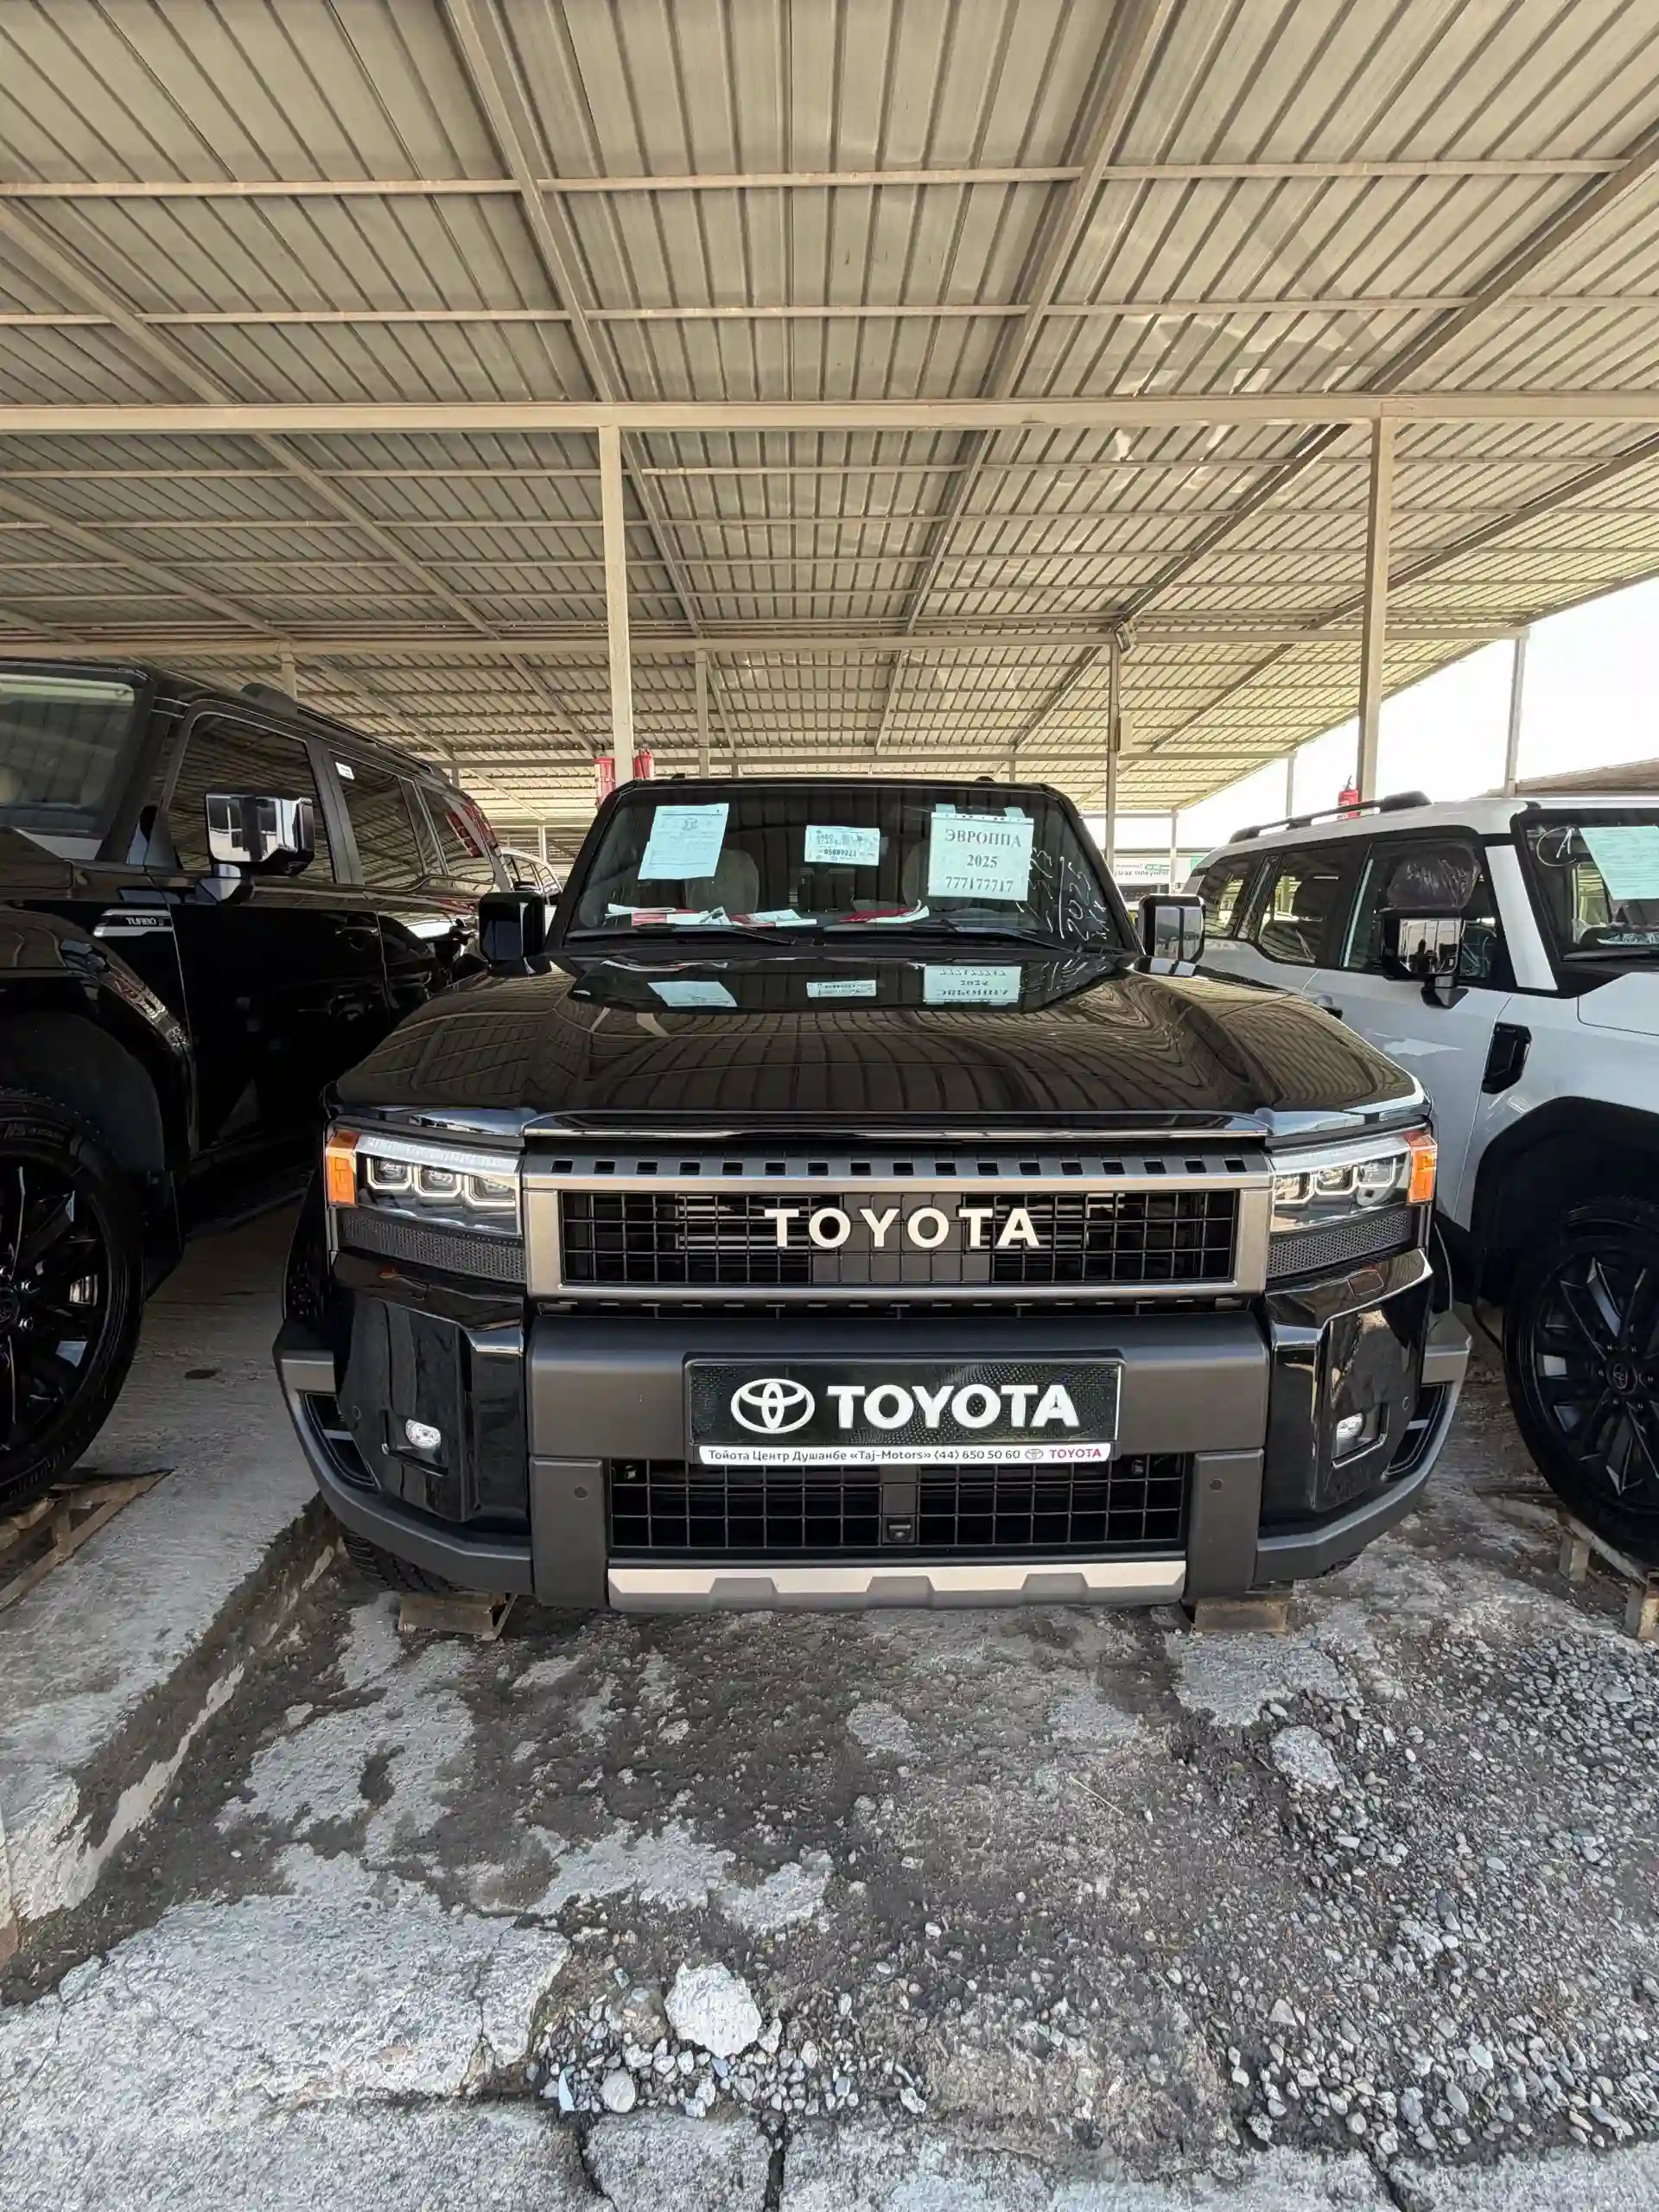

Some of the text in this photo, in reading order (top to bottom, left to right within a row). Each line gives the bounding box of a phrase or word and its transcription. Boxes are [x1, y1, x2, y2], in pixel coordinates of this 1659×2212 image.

[945, 830, 1022, 848] ЭВРОППА
[966, 854, 999, 868] 2025
[944, 876, 1014, 893] 777177717
[125, 917, 157, 925] TURBO
[765, 1207, 1040, 1249] TOYOTA
[827, 1384, 1080, 1429] TOYOTA
[709, 1448, 1103, 1462] Тойота Центр Душанбе «Taj-Motors» (44) 650 50 60 TOYOTA
